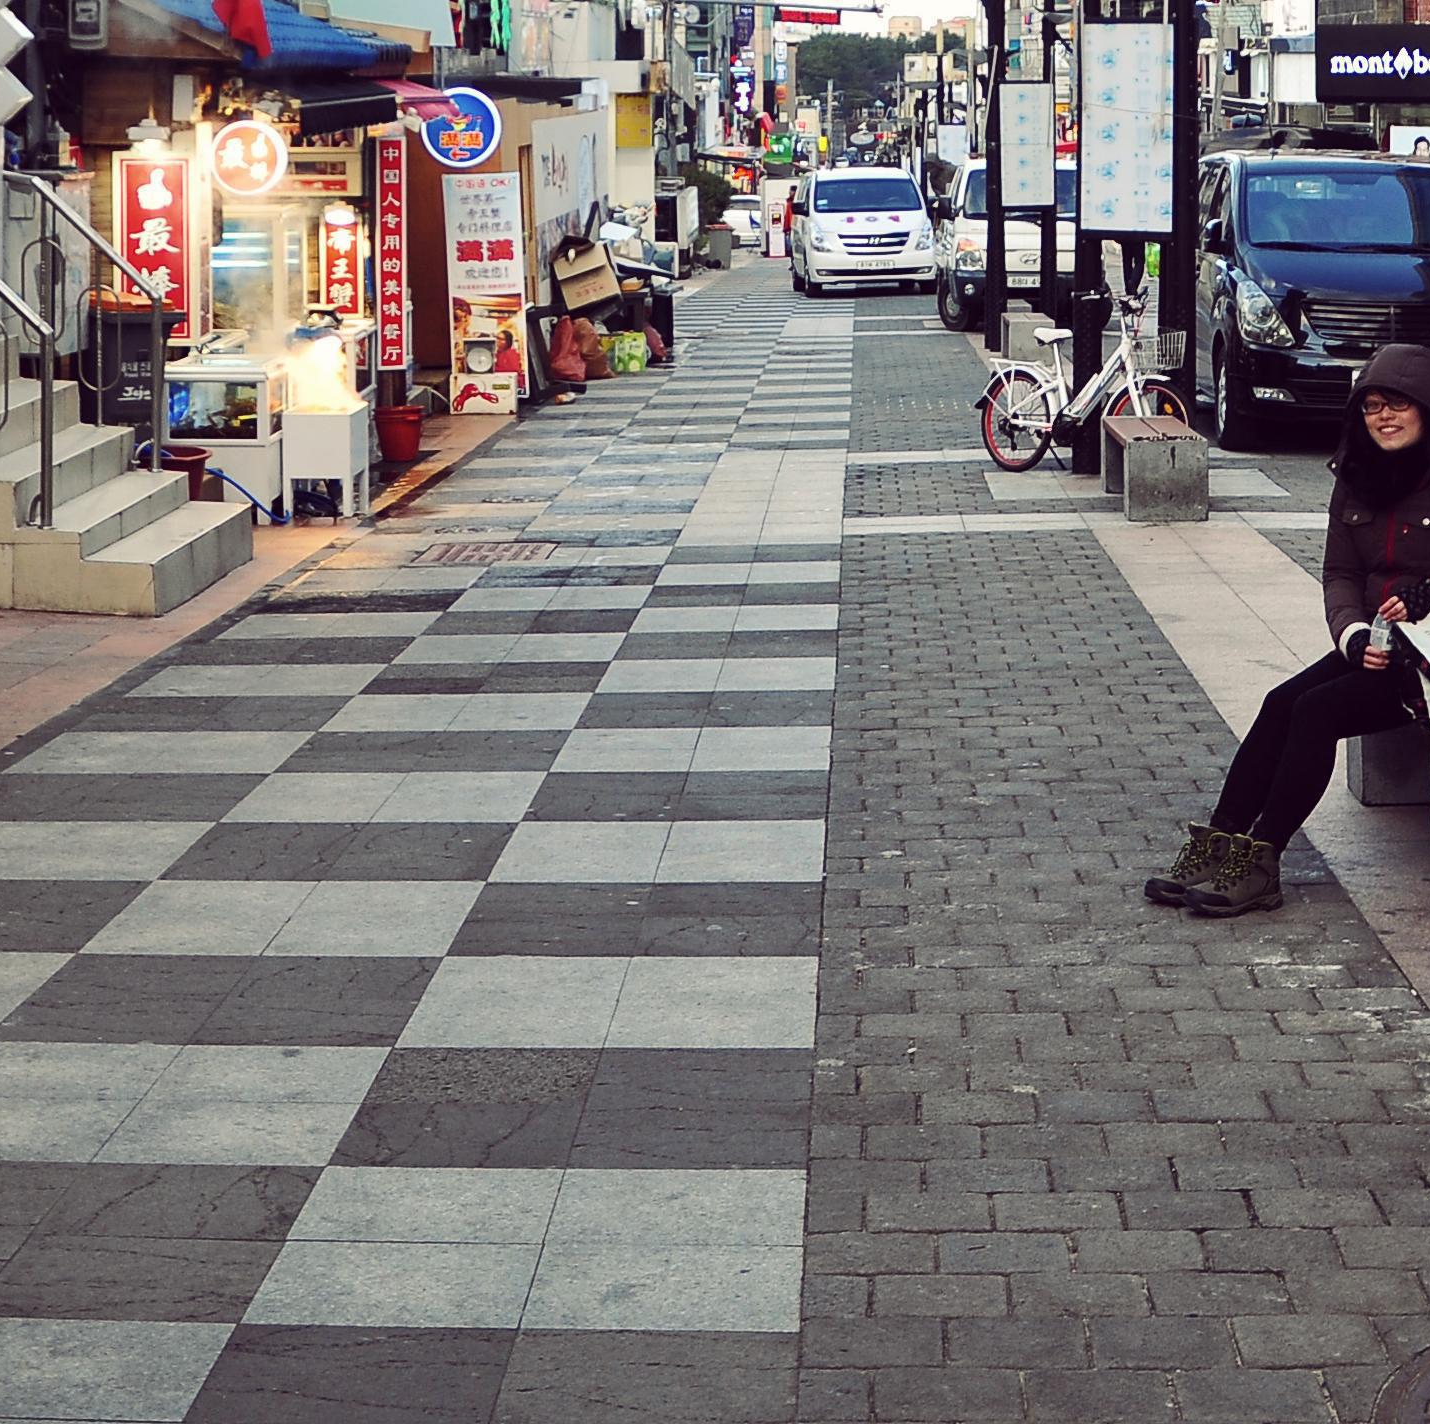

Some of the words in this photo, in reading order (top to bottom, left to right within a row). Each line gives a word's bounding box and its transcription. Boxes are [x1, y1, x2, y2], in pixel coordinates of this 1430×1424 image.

[326, 228, 356, 310] 帝王蟹
[381, 146, 402, 362] 中国人专用的美味餐厅
